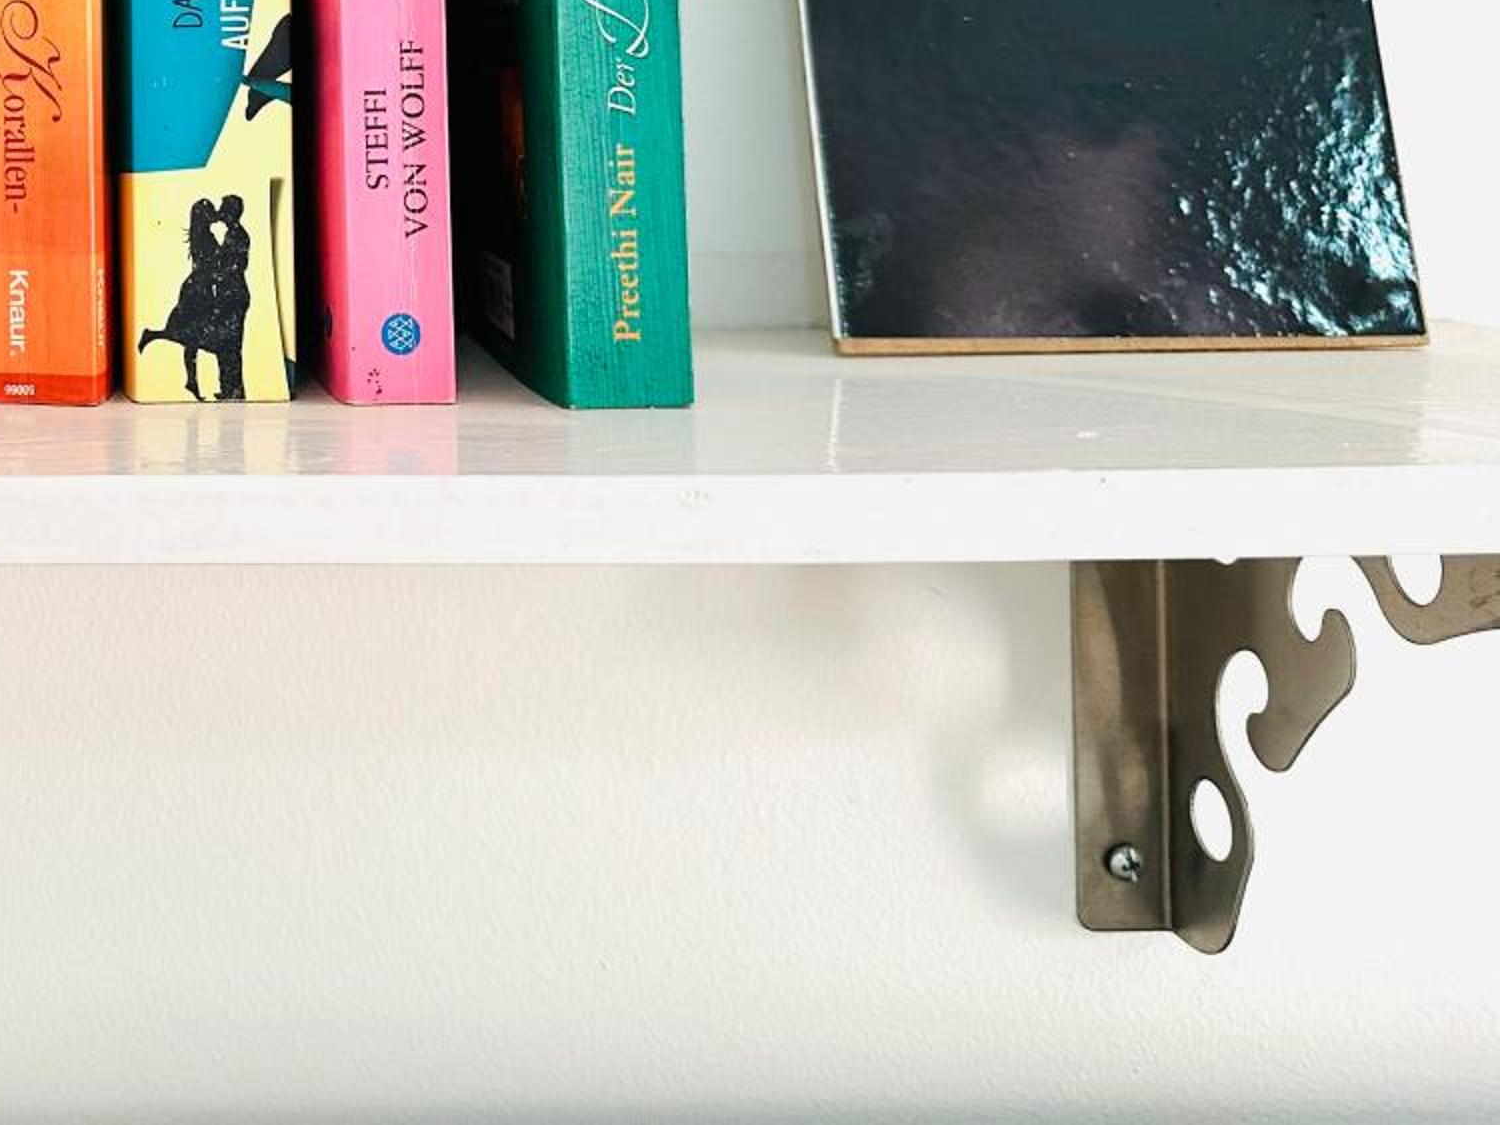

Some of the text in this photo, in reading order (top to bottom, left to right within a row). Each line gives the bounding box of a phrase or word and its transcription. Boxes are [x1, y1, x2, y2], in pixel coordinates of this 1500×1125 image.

[1, 0, 63, 215] Korallen-
[608, 58, 636, 115] Der
[364, 88, 389, 190] STEFFI
[399, 40, 429, 238] VON WOLFF
[609, 143, 637, 218] Nair
[8, 269, 30, 356] Knaur.
[611, 231, 640, 343] Preethi
